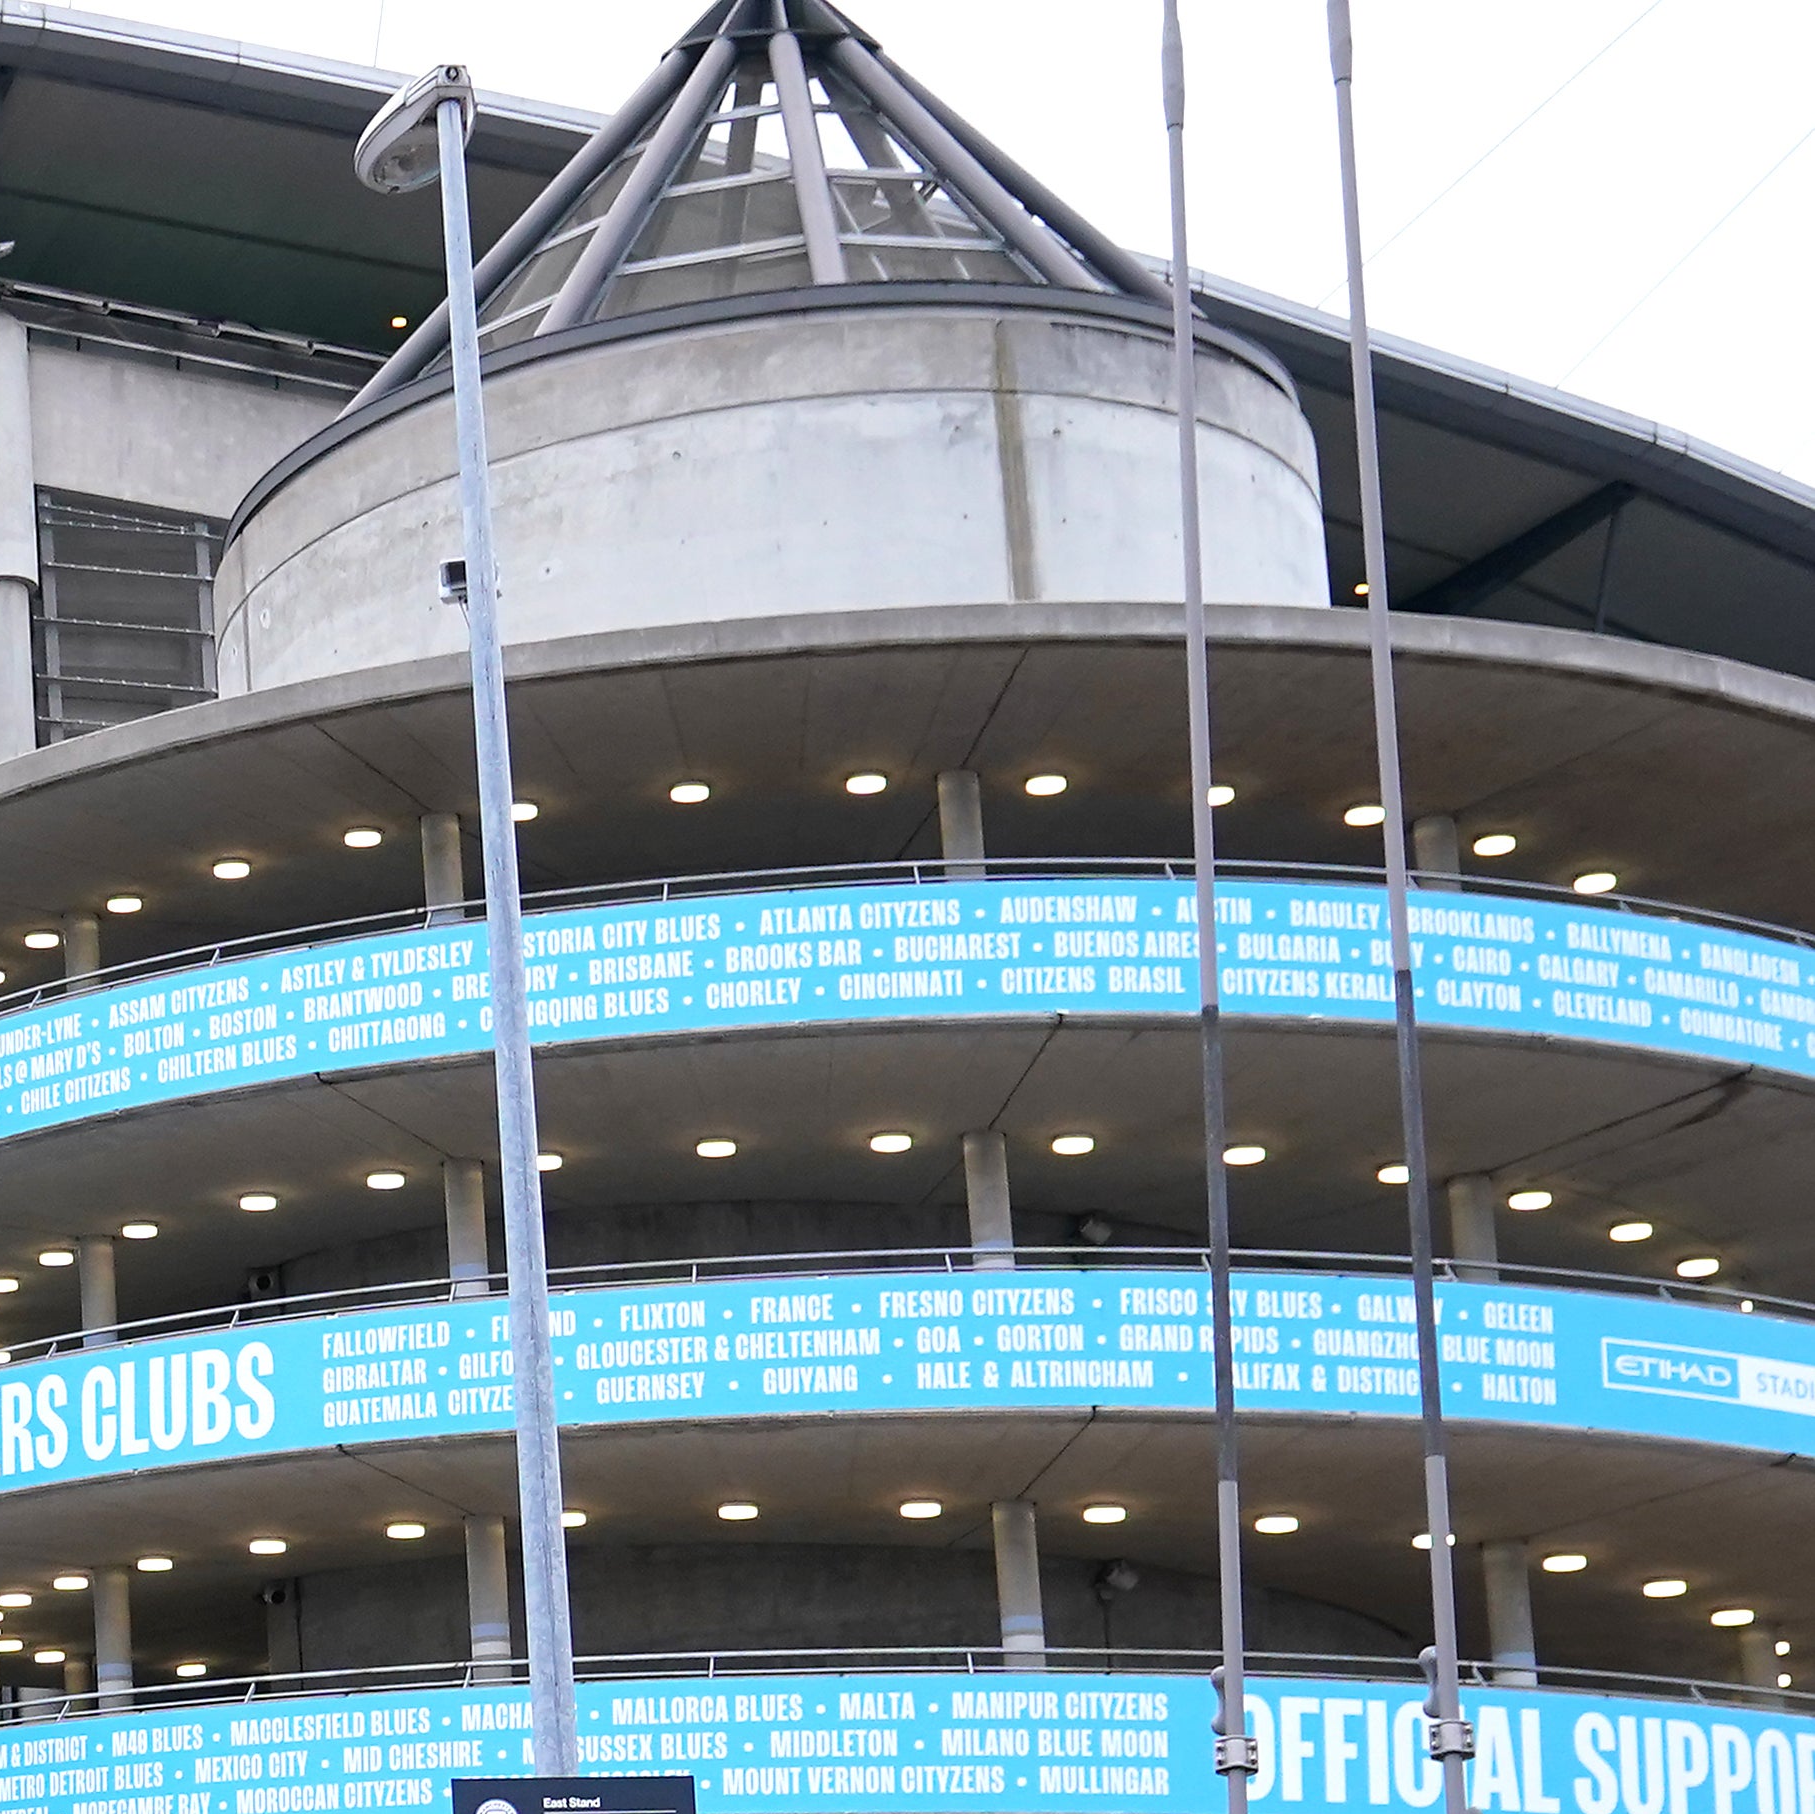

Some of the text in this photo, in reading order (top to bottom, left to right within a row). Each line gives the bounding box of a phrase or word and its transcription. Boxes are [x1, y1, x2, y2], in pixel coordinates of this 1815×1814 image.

[109, 899, 1799, 1029] ASSAM ASTLEY BLUES CITYZENS BROOKLANDS BANGLADESH
[31, 931, 1739, 1080] MARY BRANTWOOD BROOKS BUENOS BULGARIA CAMARILLO
[158, 966, 1783, 1083] CHILTERN CHITTAGONG CHORLEY BRASIL CLAYTON COIMBATORE
[323, 1288, 1553, 1359] FALLOWFIELD FLIXTON FRESNO CITYZENS BLUES GELEEN
[323, 1325, 1555, 1393] GIBRALTAR GLOUCESTER GOA GORTON BLUE MOON
[1615, 1355, 1732, 1387] ETIHAD
[81, 1341, 275, 1462] CLUBS
[324, 1360, 1556, 1427] GUATEMALA GUERNSEY GUIYANG HALE ALTRINCHAM HALTON
[152, 1724, 203, 1752] BLUES
[371, 1708, 430, 1736] BLUES
[613, 1696, 728, 1725] MALLORCA
[840, 1692, 915, 1720] MALTA
[1065, 1692, 1167, 1721] CITYZENS
[195, 1754, 262, 1783] MEXICO
[344, 1746, 382, 1773] MID
[661, 1732, 727, 1760] BLUES
[942, 1729, 1029, 1756] MILANO
[1101, 1730, 1168, 1757] MOON
[1237, 1693, 1560, 1812] OFFICAL
[237, 1784, 338, 1814] MOROCCAN
[723, 1767, 801, 1795] MOUNT
[808, 1766, 894, 1793] VERNON
[1040, 1766, 1169, 1795] MULLINGAR
[543, 1797, 600, 1808] East Stand
